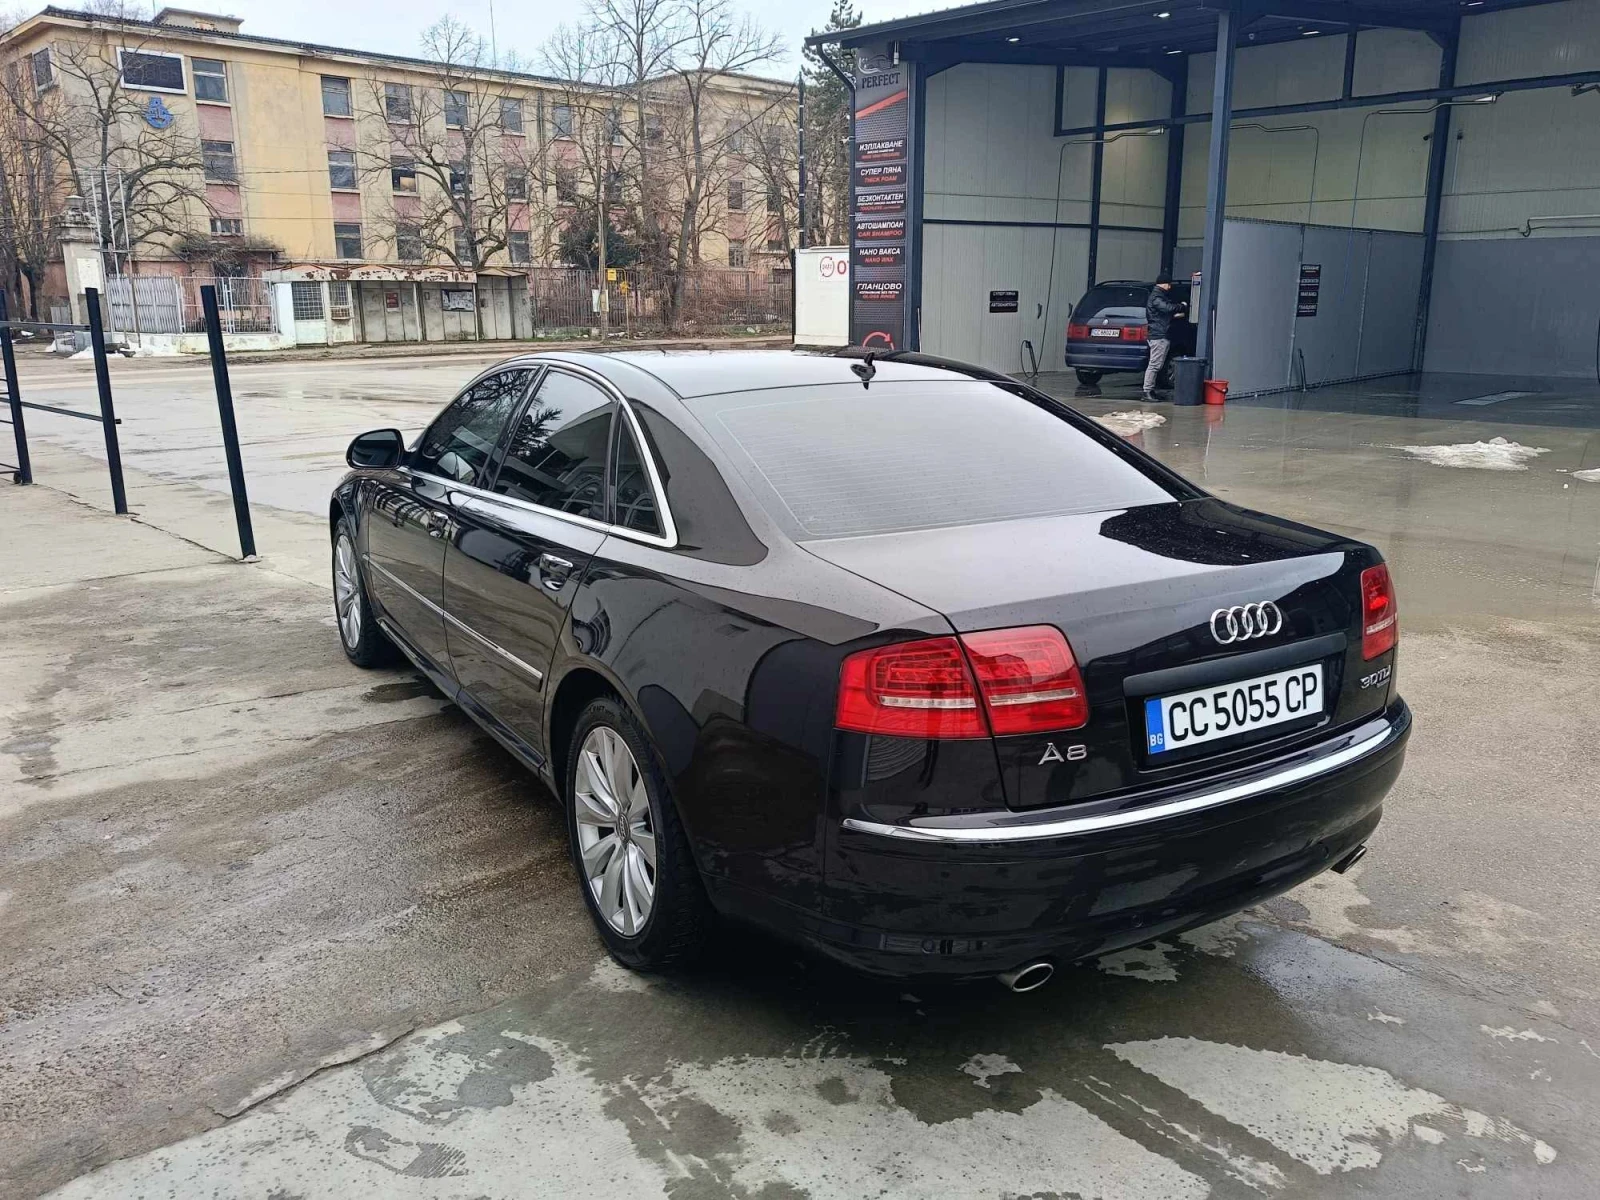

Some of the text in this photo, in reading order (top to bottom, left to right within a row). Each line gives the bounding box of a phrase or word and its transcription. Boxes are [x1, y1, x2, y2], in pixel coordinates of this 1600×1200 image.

[862, 73, 900, 88] PERFECT
[859, 140, 903, 151] ИЗПЛАКВАНЕ
[861, 166, 902, 176] СУПЕР ПЯНА
[857, 193, 904, 202] БЕЗКОНТАКТЕН
[857, 221, 904, 230] АВТОШАМПОАН
[879, 247, 900, 255] ВАКСА
[857, 283, 902, 291] ГЛАНЦОВО
[1168, 671, 1318, 742] CC 5055 CP
[1150, 733, 1164, 747] BG
[1037, 742, 1088, 765] A8
